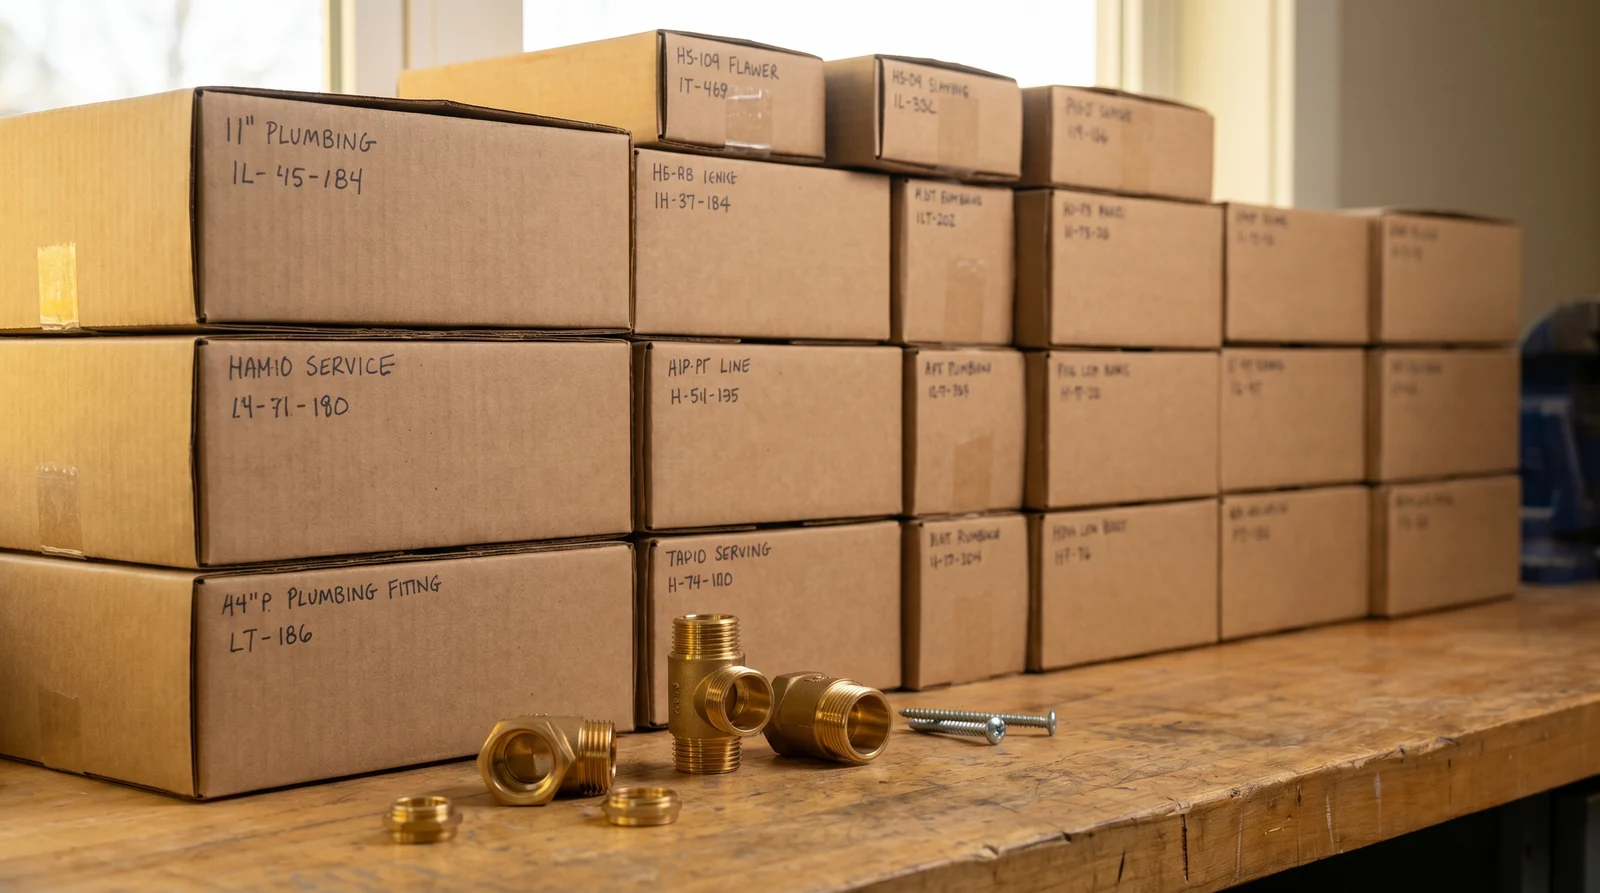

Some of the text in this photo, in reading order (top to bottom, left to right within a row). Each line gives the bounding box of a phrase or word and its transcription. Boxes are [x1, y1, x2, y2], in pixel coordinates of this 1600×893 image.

[729, 56, 779, 80] FLAWER
[266, 121, 377, 152] PLUMBING
[306, 354, 396, 376] SERVICE
[720, 358, 750, 373] LINE
[715, 542, 772, 561] SERVING
[287, 583, 378, 609] PLUMBING
[230, 624, 313, 652] LT-186
